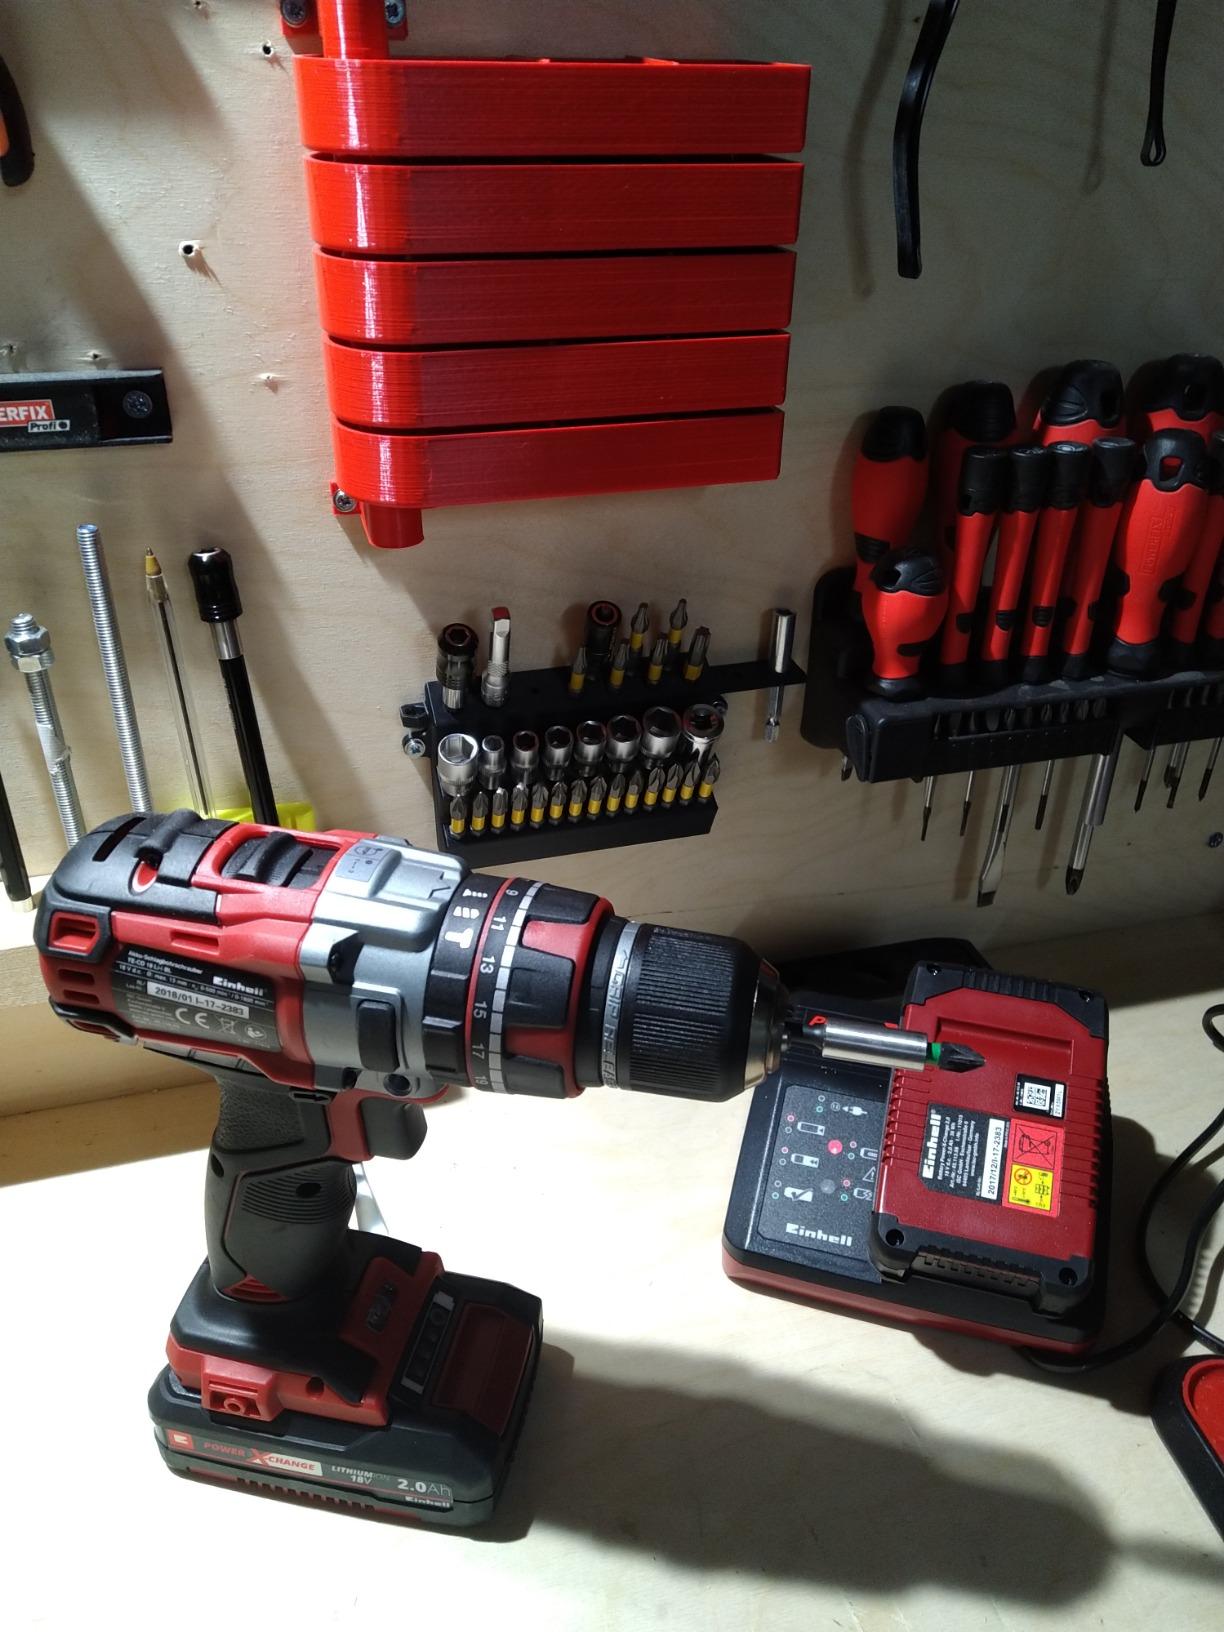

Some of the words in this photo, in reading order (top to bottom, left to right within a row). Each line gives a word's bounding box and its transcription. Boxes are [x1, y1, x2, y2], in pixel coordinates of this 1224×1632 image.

[506, 889, 518, 897] 9
[491, 916, 507, 931] 11
[480, 956, 495, 974] 13
[473, 1001, 488, 1019] 15
[472, 1042, 485, 1060] 17
[473, 1075, 489, 1086] 19
[785, 1223, 853, 1247] Einhell
[203, 1441, 246, 1457] POWER
